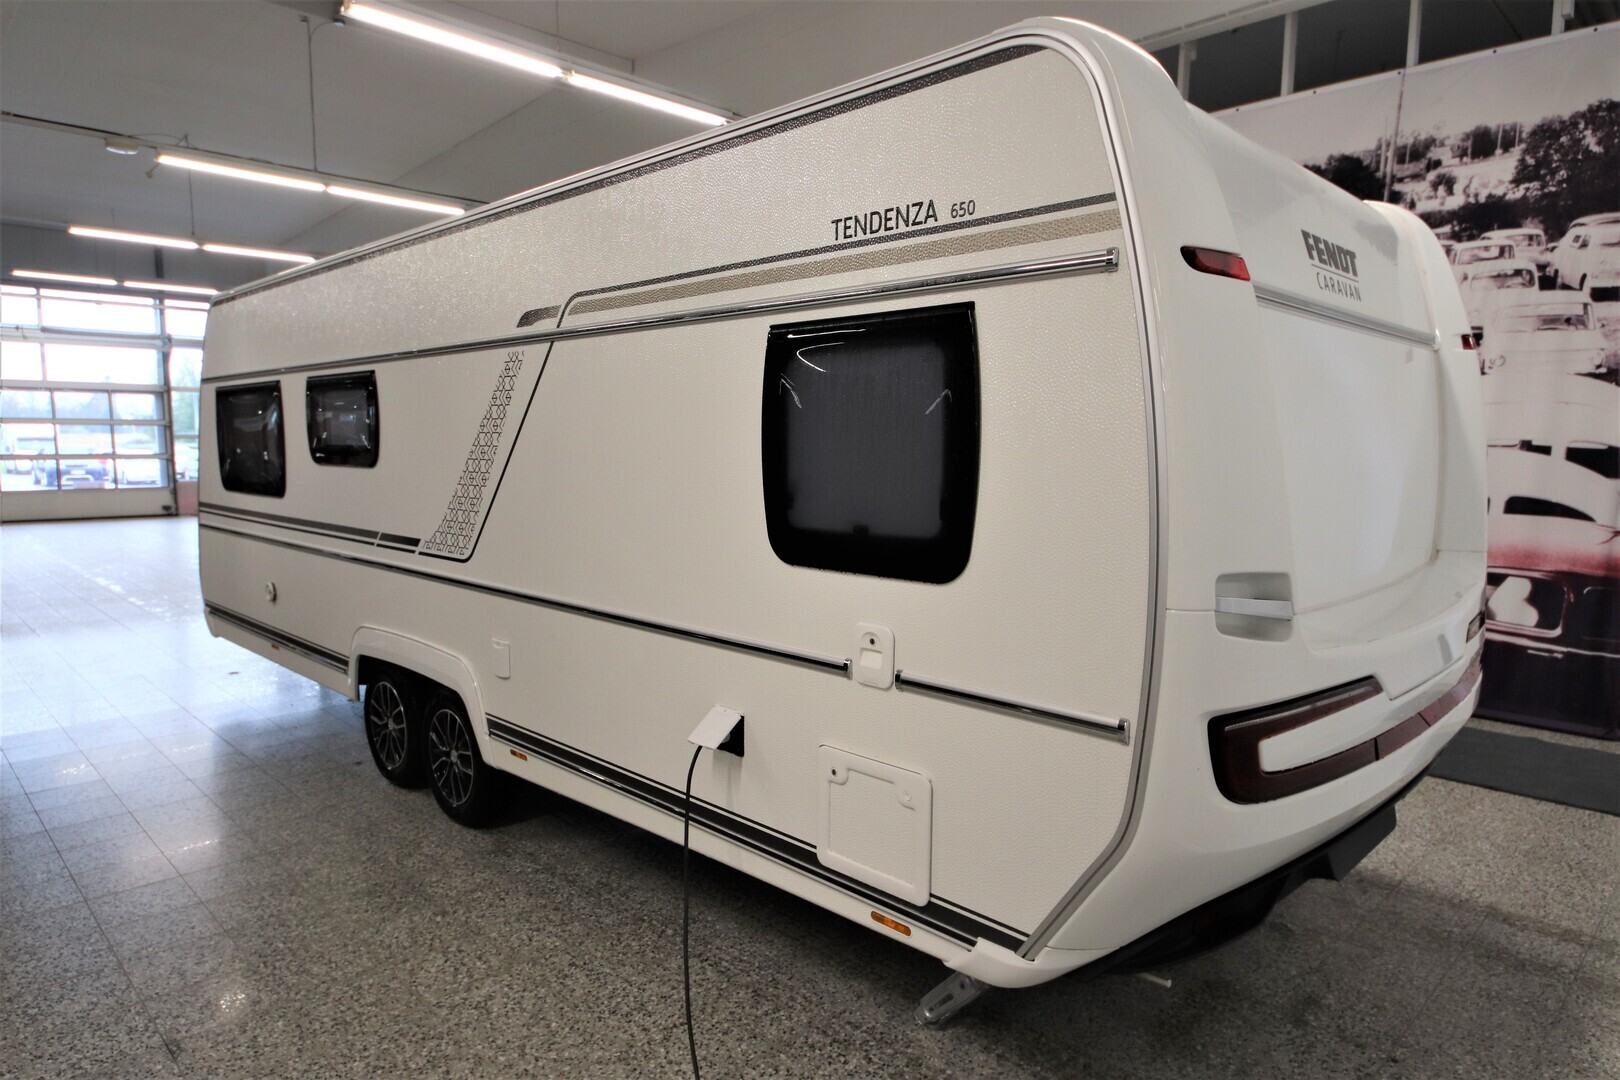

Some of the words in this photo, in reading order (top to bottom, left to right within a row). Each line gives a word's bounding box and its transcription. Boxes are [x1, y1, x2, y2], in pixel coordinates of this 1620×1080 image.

[831, 199, 938, 241] TENDENZA
[950, 200, 976, 219] 650
[1301, 229, 1358, 278] FENDT
[1316, 271, 1362, 303] CARAVAN
